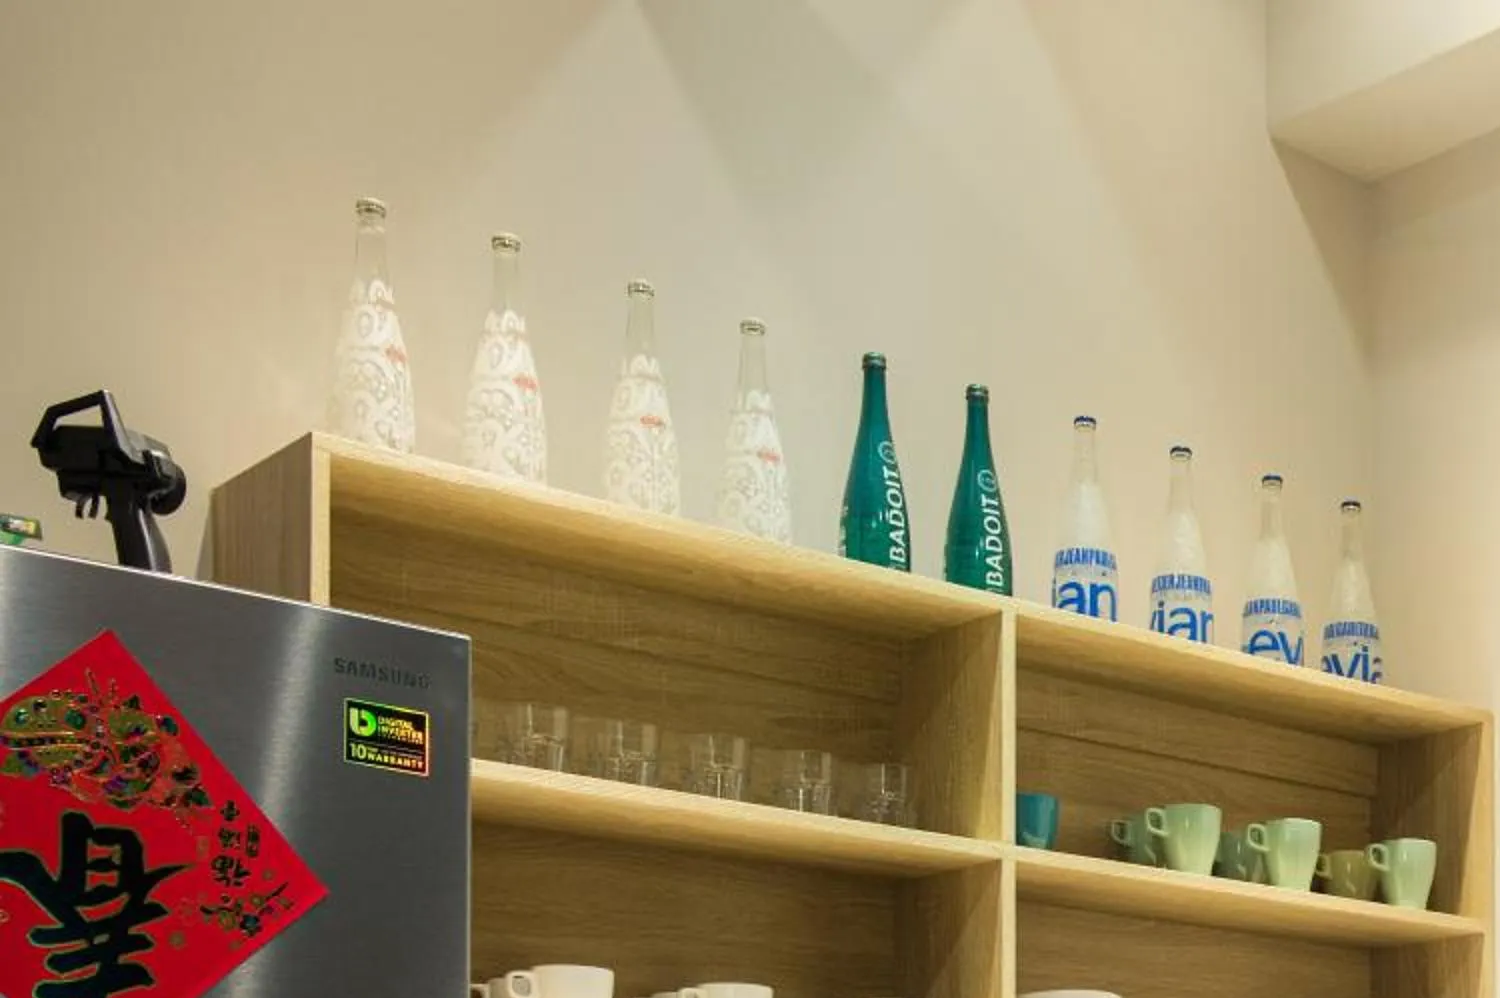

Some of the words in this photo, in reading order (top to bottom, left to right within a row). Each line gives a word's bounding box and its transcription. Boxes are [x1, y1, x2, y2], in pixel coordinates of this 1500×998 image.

[881, 465, 906, 563] BADOIT
[980, 493, 1004, 587] BADOIT
[334, 657, 431, 689] SAMSUNG
[349, 742, 366, 759] 10
